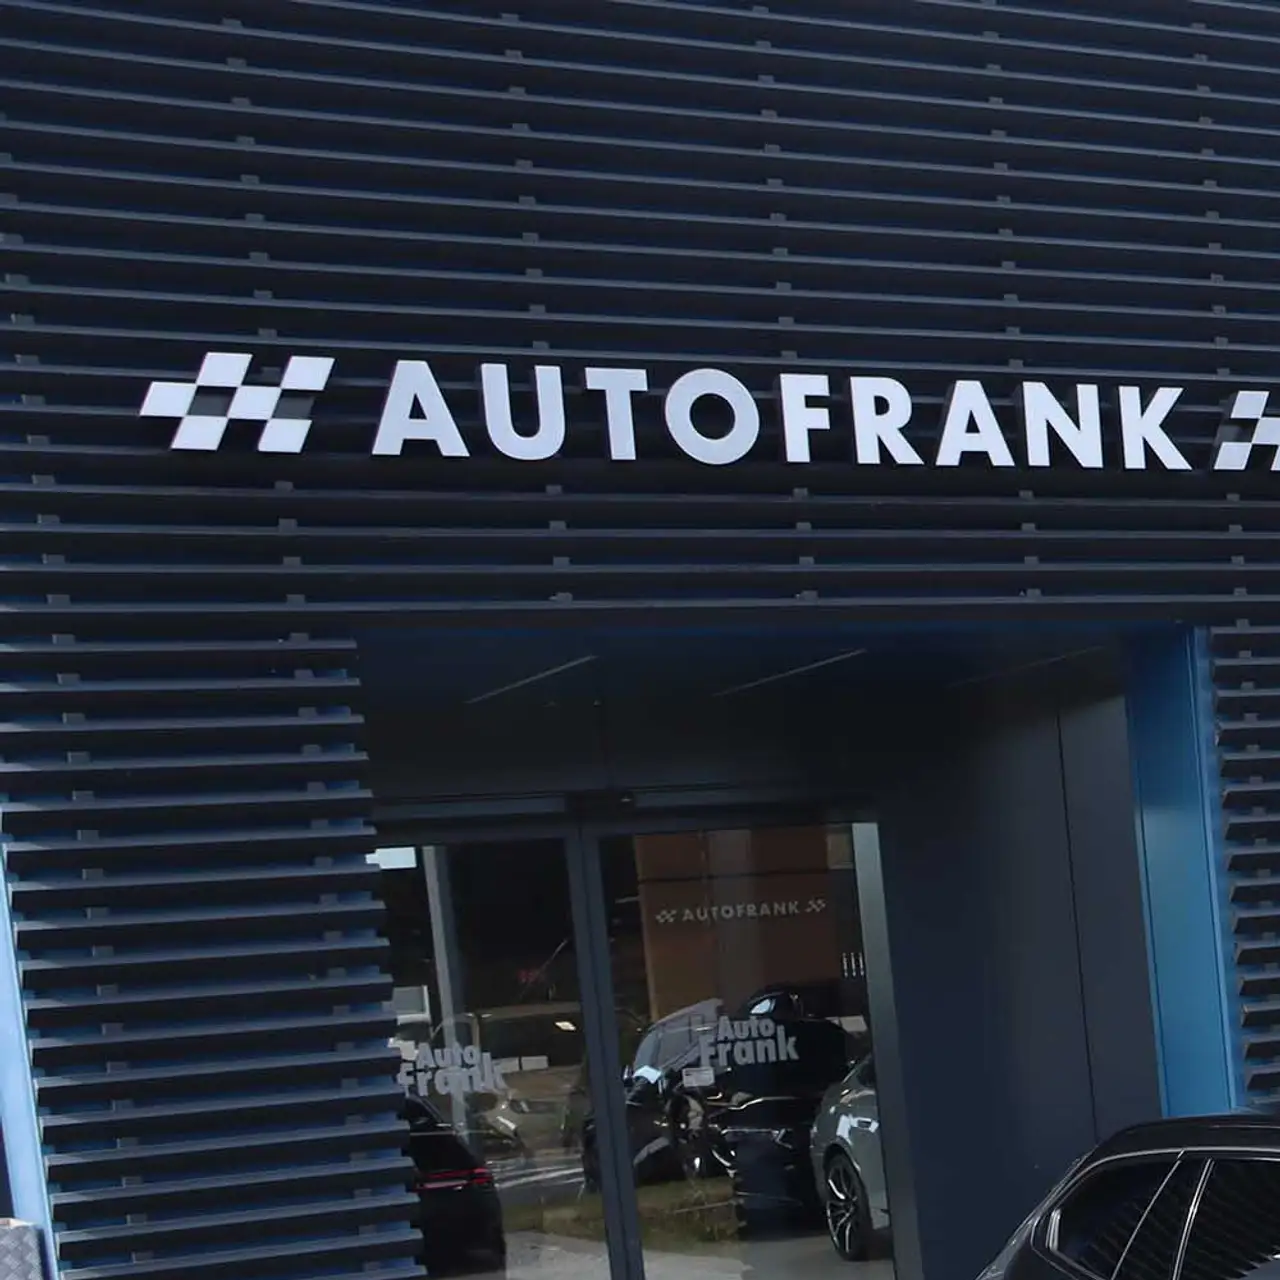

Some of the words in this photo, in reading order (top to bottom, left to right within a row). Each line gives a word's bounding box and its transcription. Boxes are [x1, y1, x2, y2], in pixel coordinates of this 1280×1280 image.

[371, 359, 1191, 471] AUTOFRANK
[681, 901, 801, 923] AUTOFRANK
[717, 1015, 775, 1041] Auto
[699, 1024, 799, 1068] Frank
